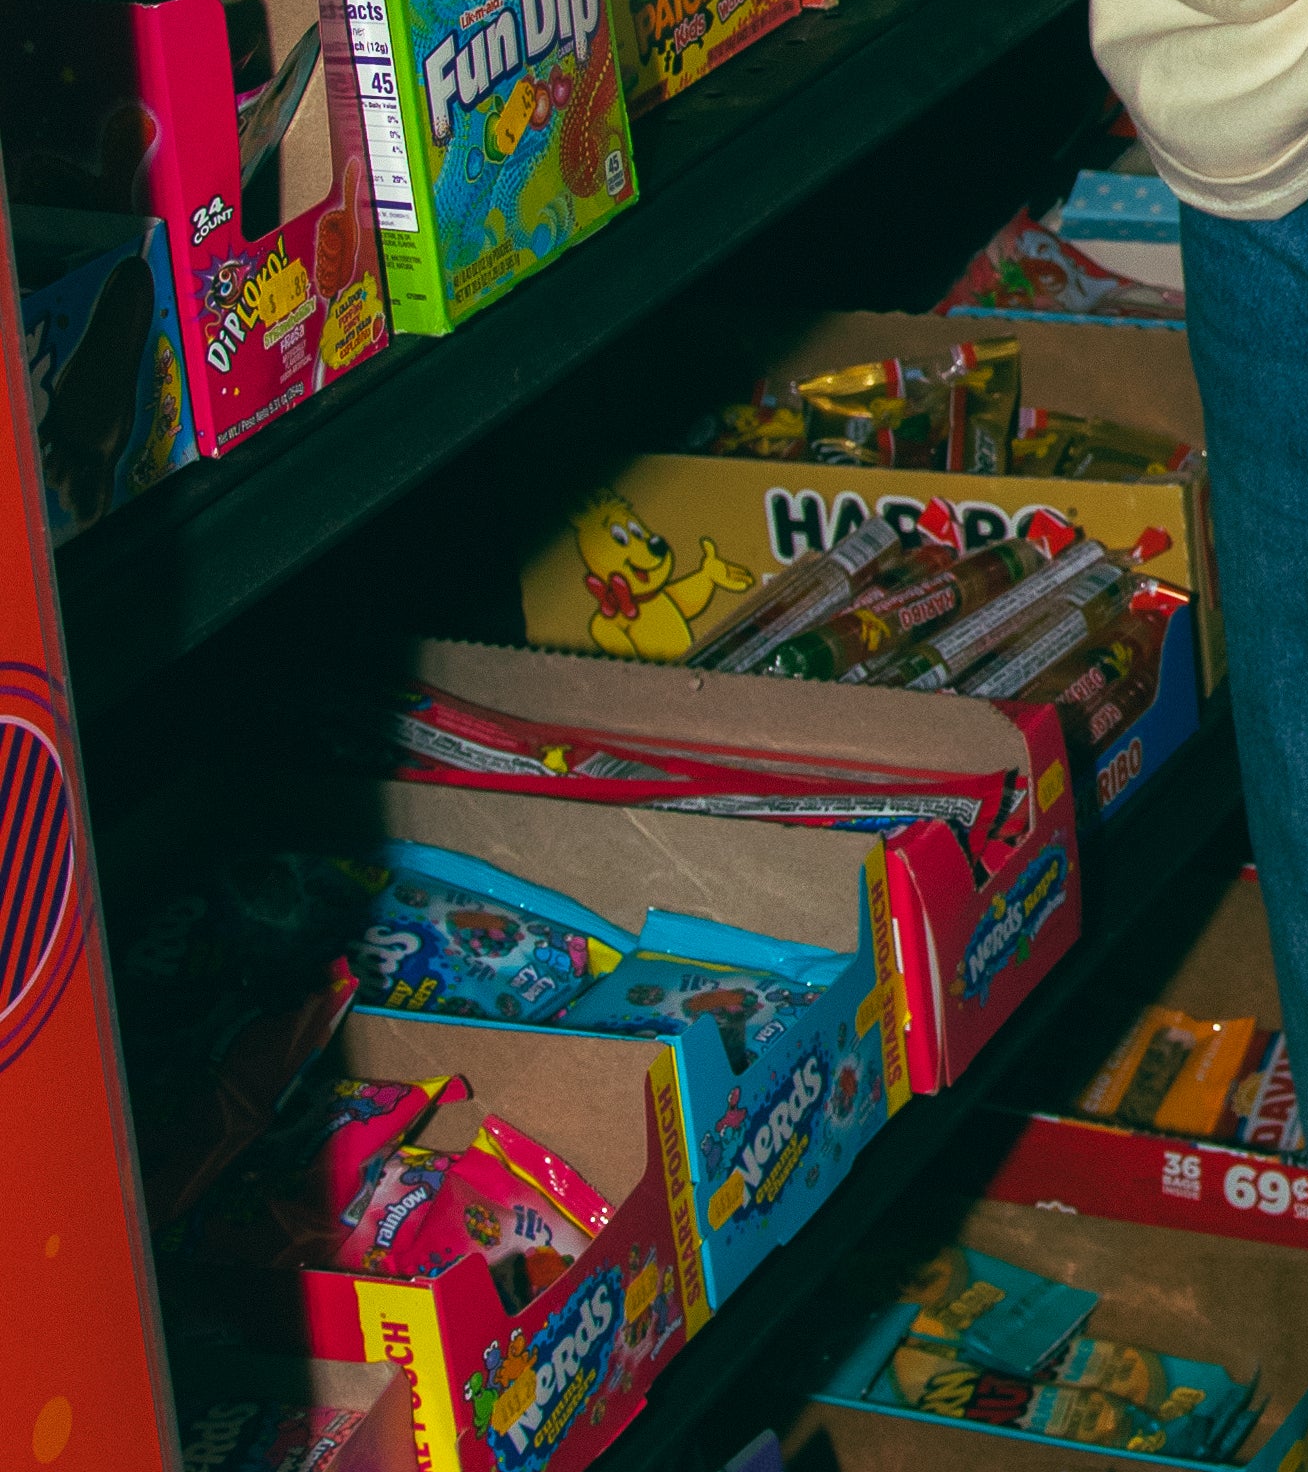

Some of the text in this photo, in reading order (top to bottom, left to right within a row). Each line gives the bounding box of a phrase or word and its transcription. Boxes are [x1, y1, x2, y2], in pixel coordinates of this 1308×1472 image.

[366, 39, 389, 55] (12g)
[673, 11, 707, 55] Kids
[371, 73, 394, 95] 45
[424, 10, 520, 145] Fun
[608, 155, 619, 174] 45
[192, 208, 234, 246] COUNT
[193, 196, 225, 229] 24
[763, 486, 1070, 565] HARB
[966, 887, 1025, 981] Nerds
[871, 879, 904, 1090] SHARE POUCH
[741, 1058, 823, 1208] Nerds
[657, 1083, 700, 1308] SHARE POUCH
[1162, 1152, 1201, 1180] 36
[376, 1186, 428, 1246] rainbow
[506, 1284, 614, 1455] Nerds
